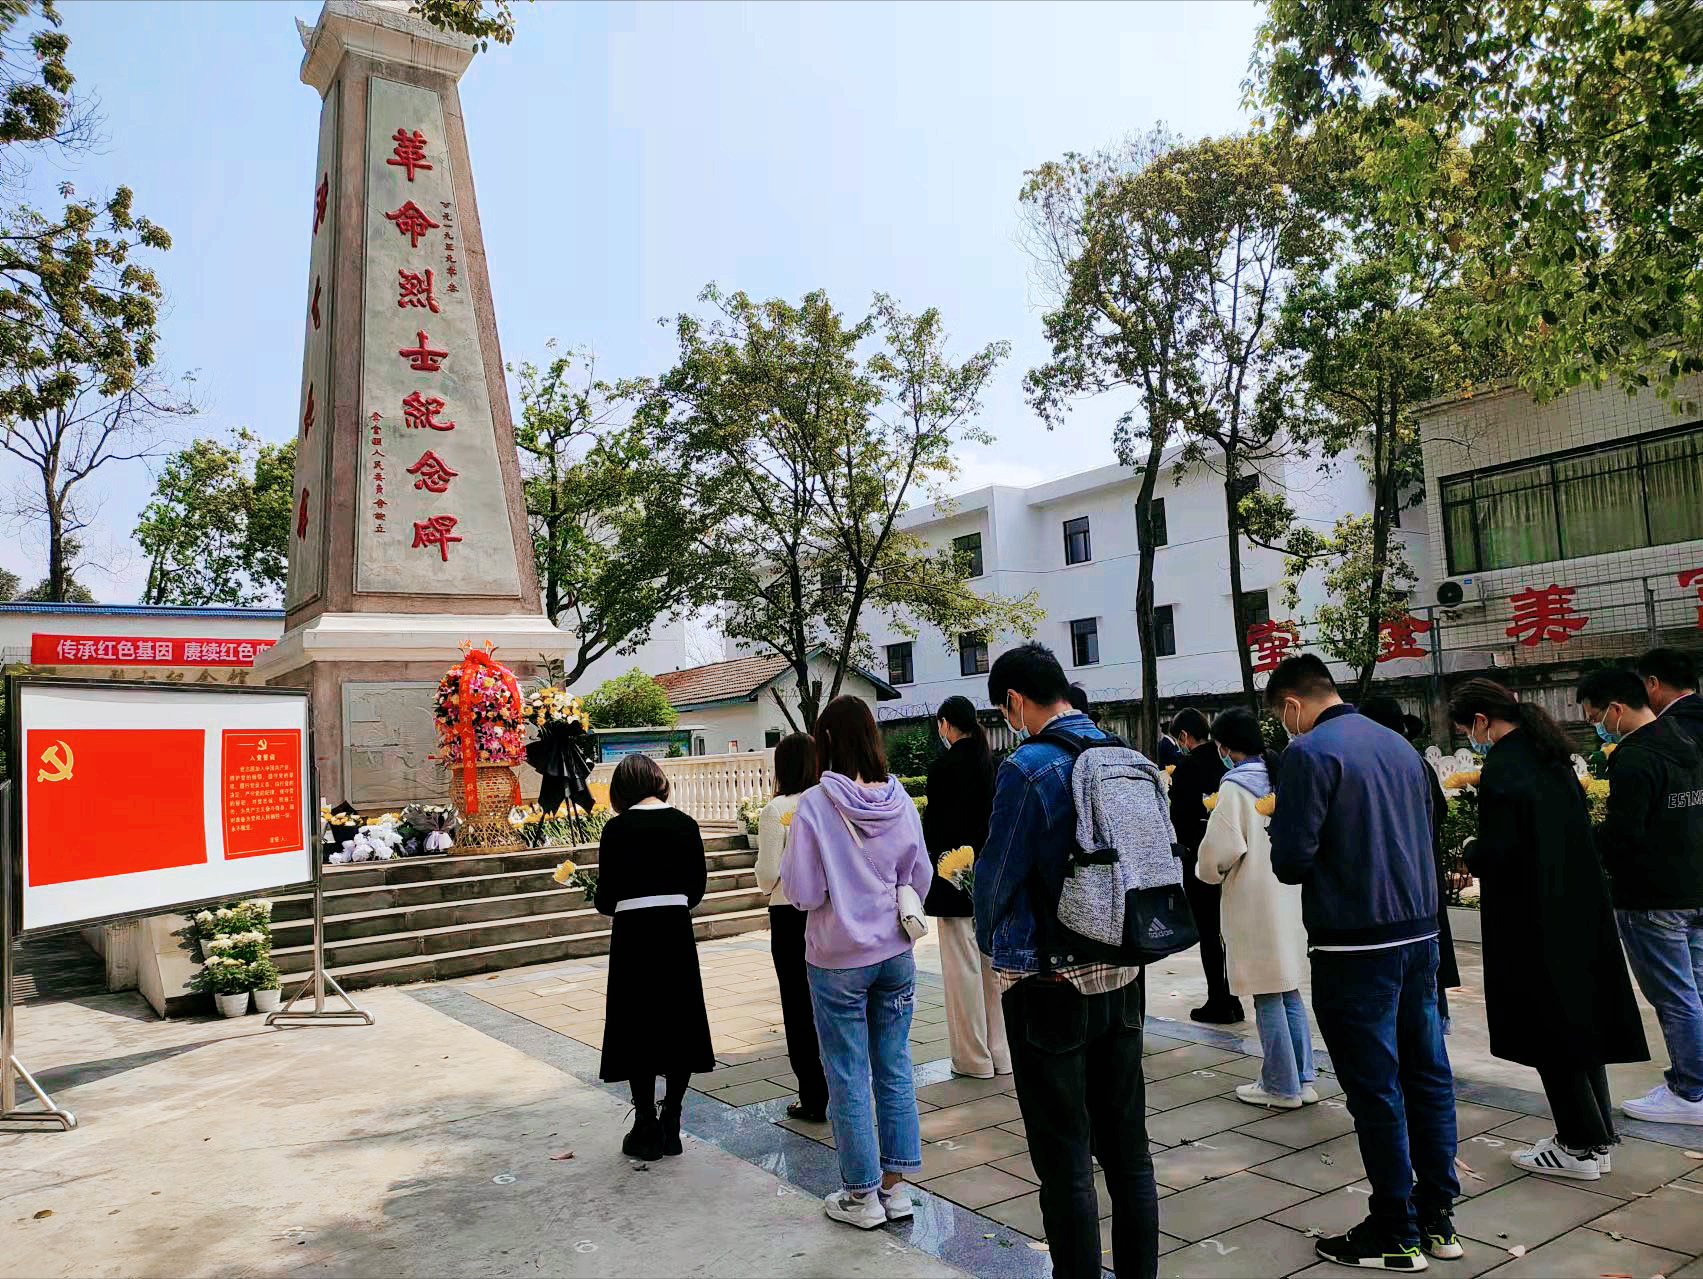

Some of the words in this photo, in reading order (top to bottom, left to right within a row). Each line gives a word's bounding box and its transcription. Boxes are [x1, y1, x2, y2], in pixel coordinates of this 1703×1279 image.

[57, 639, 172, 661] 传承红色基因
